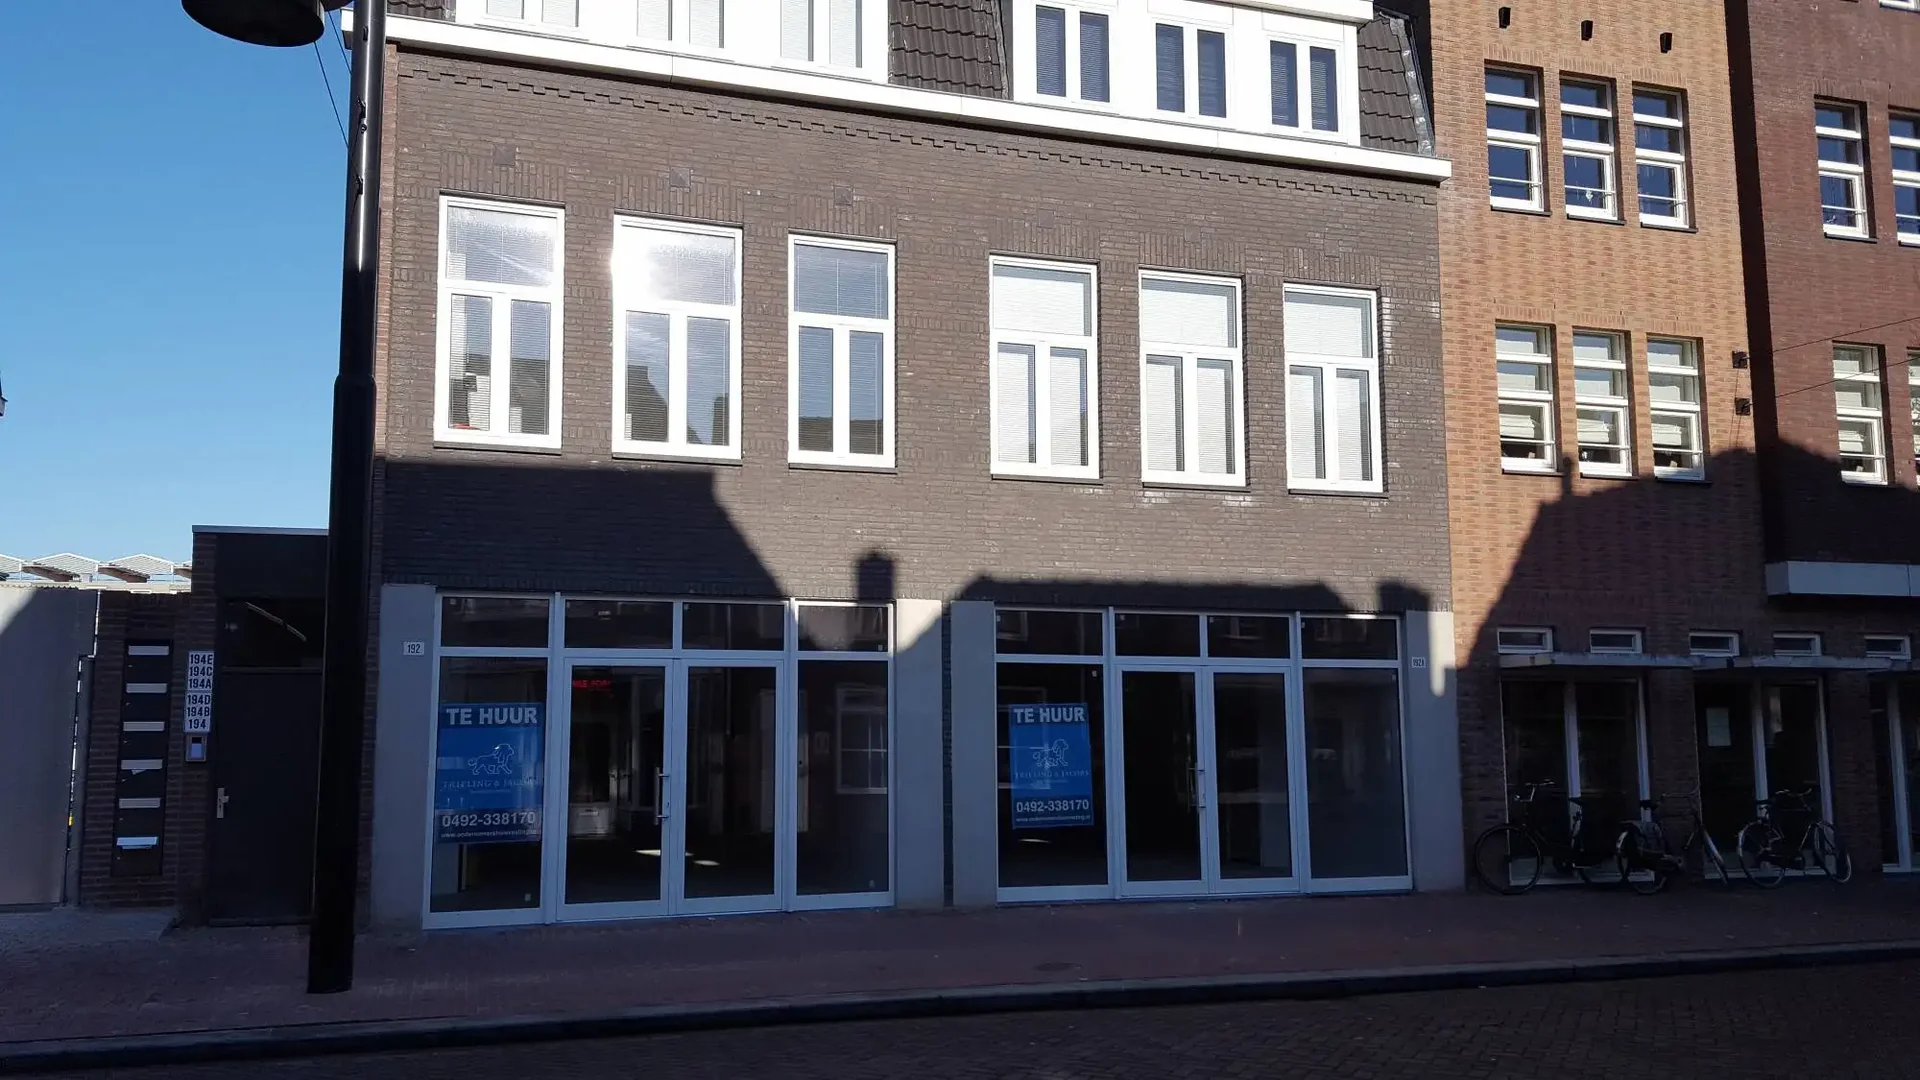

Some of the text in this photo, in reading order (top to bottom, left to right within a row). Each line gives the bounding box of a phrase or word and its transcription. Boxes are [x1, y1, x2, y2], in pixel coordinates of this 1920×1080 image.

[407, 643, 421, 654] 192
[190, 654, 213, 664] 194E
[190, 666, 213, 676] 194C
[189, 678, 212, 689] 194A
[187, 694, 211, 705] 194D
[186, 706, 210, 717] 194B
[446, 707, 538, 725] TE HUUR
[1014, 707, 1085, 723] TE HUUR
[189, 719, 206, 729] 194
[1016, 800, 1089, 812] 0492-338170
[442, 812, 536, 827] 0492-338170
